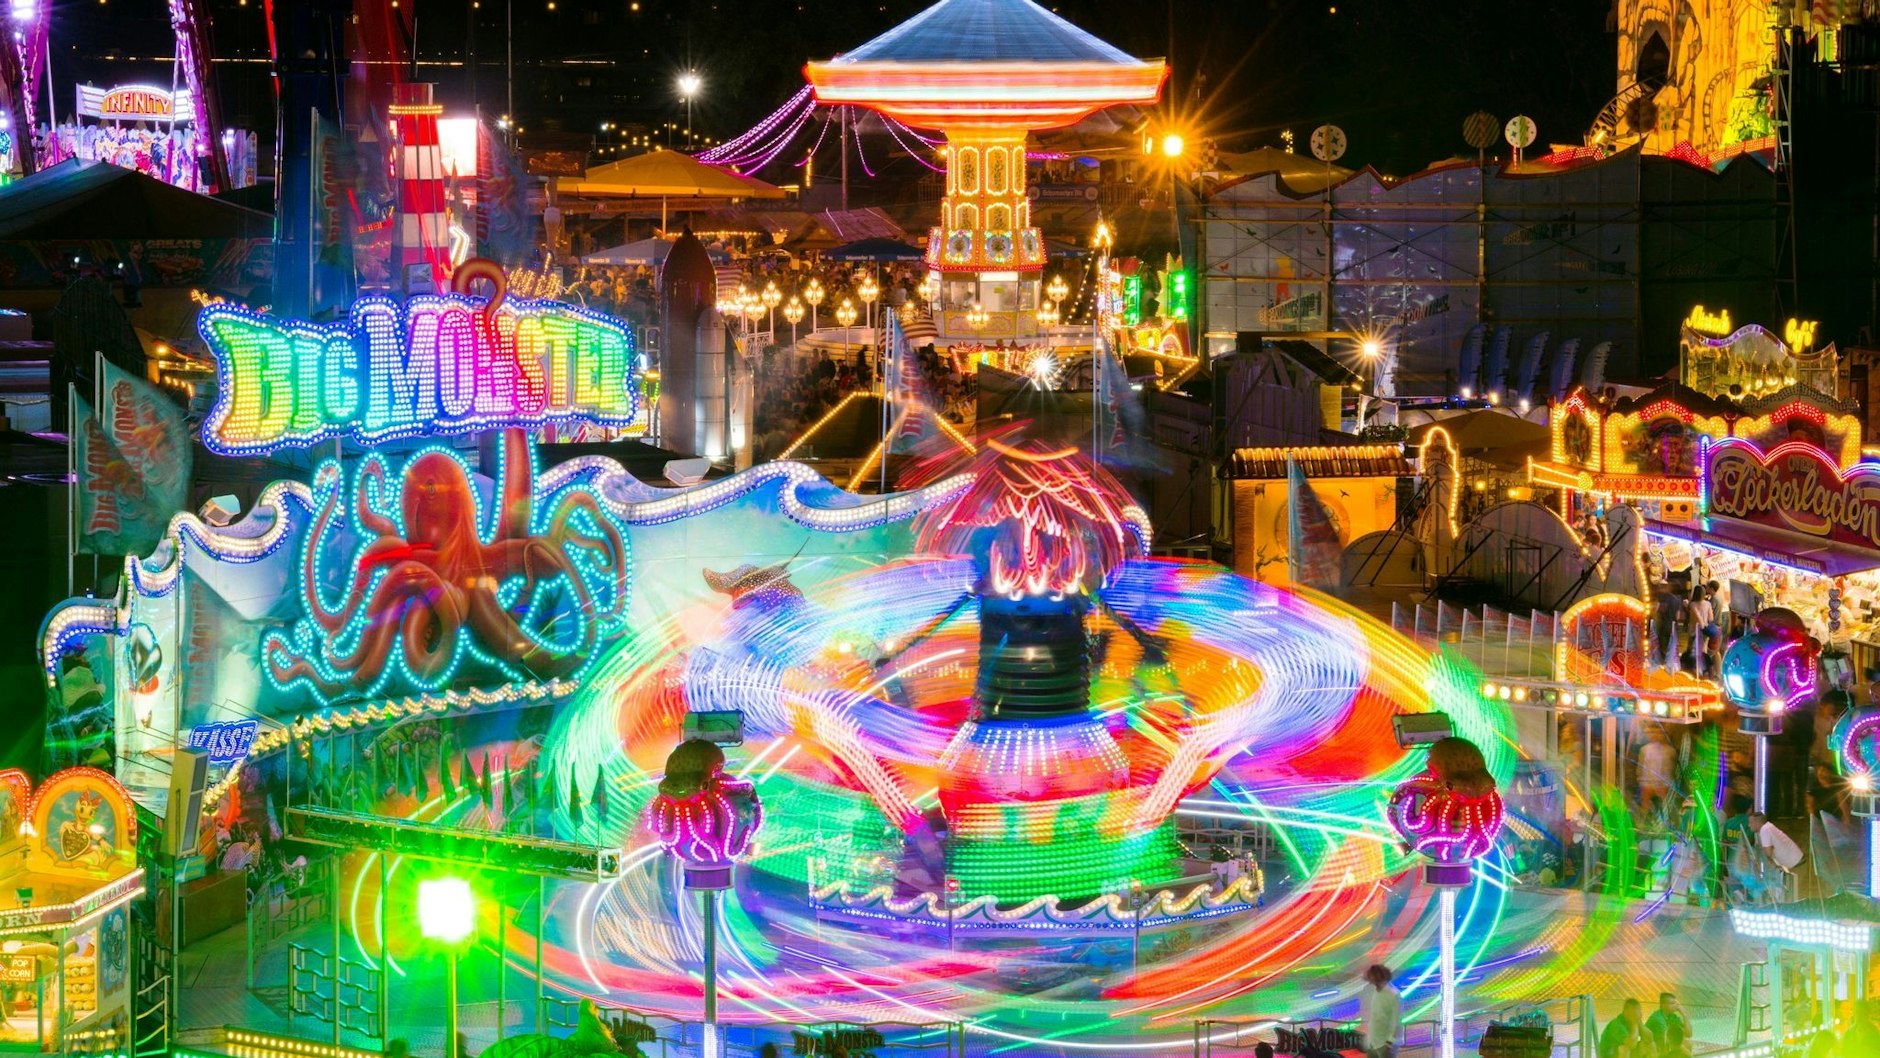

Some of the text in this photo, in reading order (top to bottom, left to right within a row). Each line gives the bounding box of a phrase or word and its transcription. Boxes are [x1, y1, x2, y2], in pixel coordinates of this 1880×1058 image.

[106, 91, 170, 115] INFINITY
[213, 308, 631, 440] BIG MONSTER
[1711, 457, 1880, 548] Leckerladen
[9, 968, 31, 978] CORN
[12, 958, 29, 967] POP
